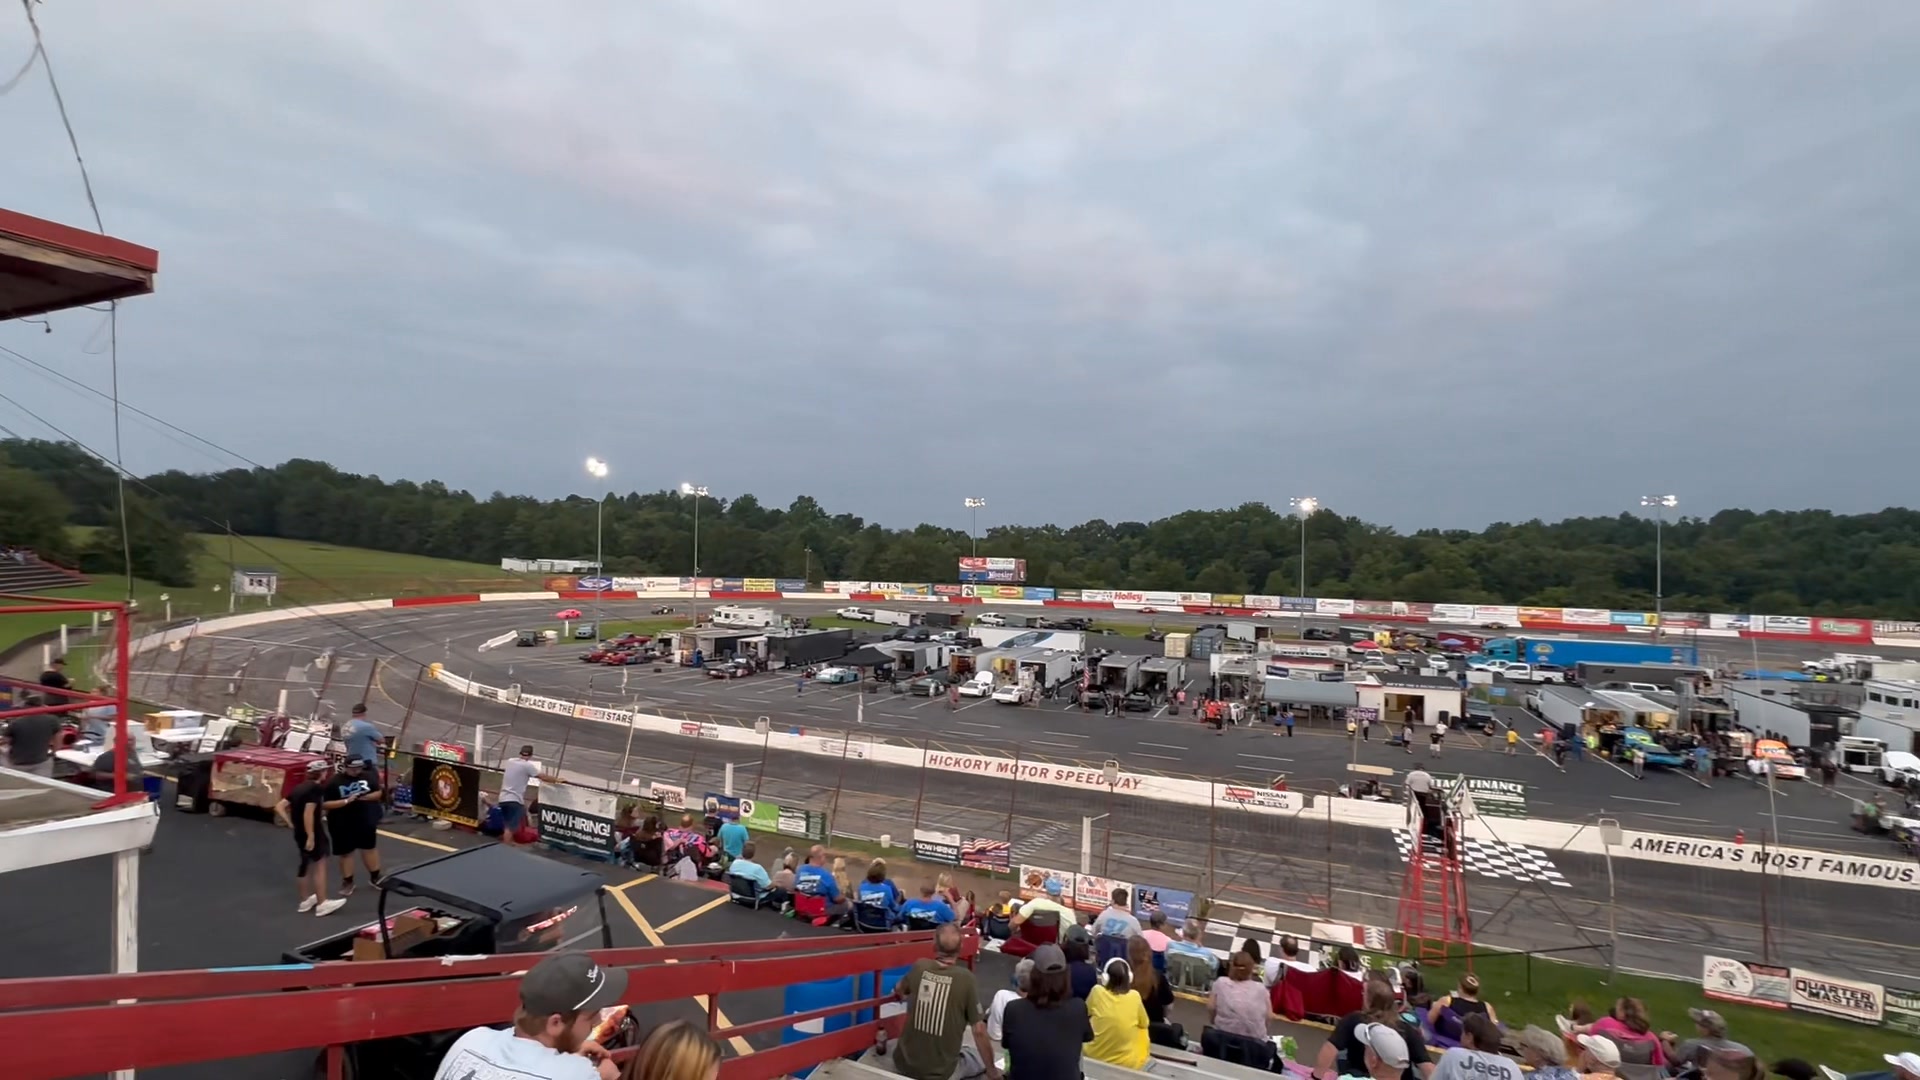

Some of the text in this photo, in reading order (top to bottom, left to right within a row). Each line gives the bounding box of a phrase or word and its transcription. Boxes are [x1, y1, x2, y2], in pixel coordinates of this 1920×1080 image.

[1114, 591, 1142, 603] Holley
[547, 701, 557, 710] OF
[559, 703, 573, 714] THE
[606, 712, 633, 724] STARS
[928, 754, 992, 771] HICKORY
[996, 762, 1050, 779] MOTOR
[1469, 779, 1525, 794] FINANCE
[1256, 791, 1287, 799] NISSAN
[541, 809, 611, 837] NOW HIRING!
[915, 842, 933, 851] NOW
[933, 845, 958, 855] HIRING!
[1629, 837, 1915, 883] AMERICA'S MOST FAMOUS
[921, 970, 953, 985] FREEDOM
[1795, 980, 1871, 1001] QUARTER
[1808, 989, 1875, 1011] MASTER
[1459, 1055, 1512, 1080] Jeep
